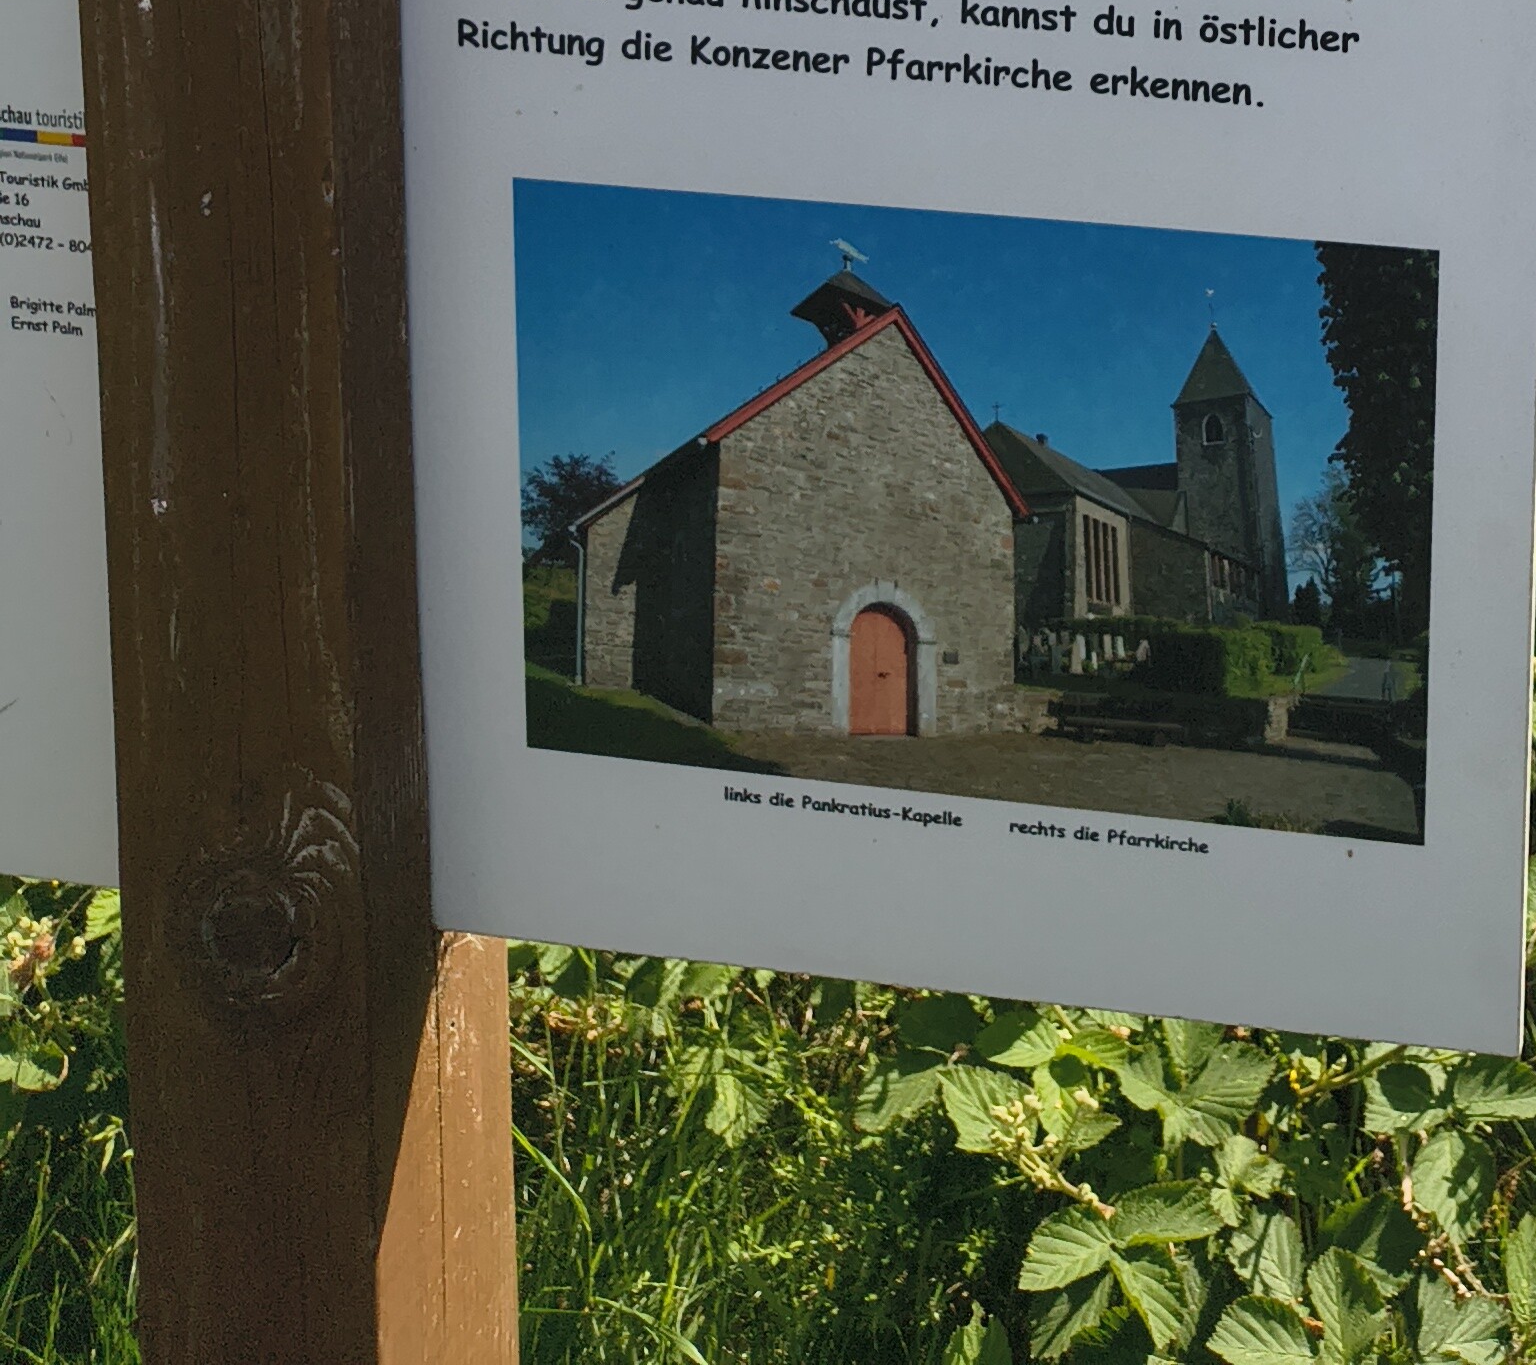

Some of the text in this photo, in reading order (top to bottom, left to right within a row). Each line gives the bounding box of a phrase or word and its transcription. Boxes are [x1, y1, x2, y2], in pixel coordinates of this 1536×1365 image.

[1094, 5, 1134, 37] du
[1154, 10, 1182, 41] in
[1200, 15, 1359, 53] östlicher
[458, 18, 1263, 107] Richtung die Konzener Pfarrkirche erkennen.
[36, 109, 85, 129] touristi
[14, 192, 29, 206] 16
[10, 296, 63, 314] Brigitte
[11, 316, 83, 336] Ernst Palm
[724, 786, 962, 827] links die Pankratius-Kapelle
[1010, 821, 1209, 854] rechts die Pfarrkirche
